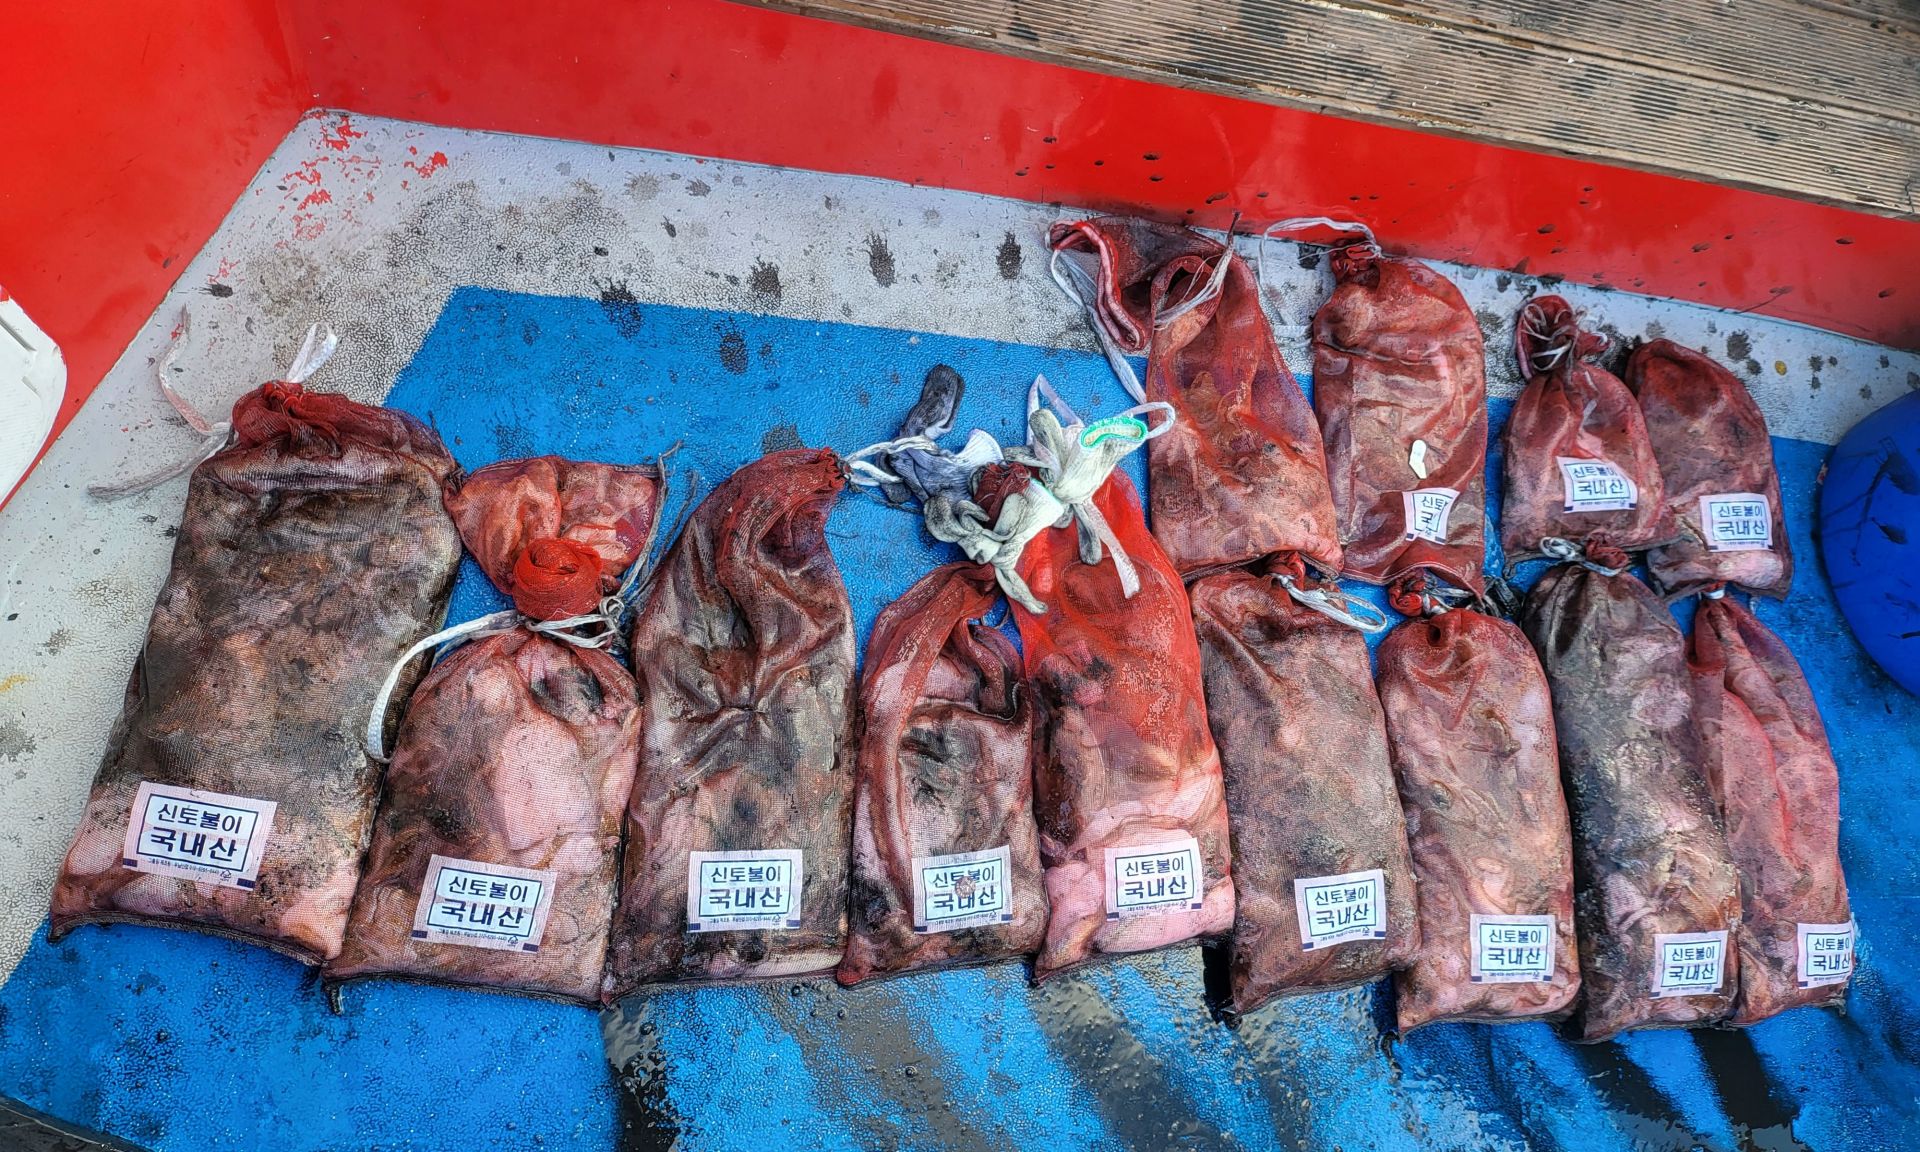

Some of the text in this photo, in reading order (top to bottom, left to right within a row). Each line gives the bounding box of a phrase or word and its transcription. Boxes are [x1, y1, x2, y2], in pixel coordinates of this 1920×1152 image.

[1577, 479, 1624, 495] 국내산
[1718, 505, 1763, 518] 신토불이
[1717, 520, 1765, 536] 국내산
[157, 803, 243, 834] 신토불이
[150, 826, 238, 862] 국내산
[711, 866, 782, 883] 신토불이
[1124, 856, 1185, 877] 신토불이
[448, 876, 529, 903] 신토불이
[1124, 875, 1188, 899] 국내산
[1314, 885, 1369, 906] 신토불이
[708, 887, 783, 909] 국내산
[933, 885, 997, 912] 국내산
[441, 898, 524, 929] 국내산
[1315, 903, 1370, 928] 국내산
[1488, 929, 1542, 943] 신토불이
[1487, 947, 1542, 966] 국내산
[1671, 945, 1715, 961] 신토불이
[1812, 952, 1851, 971] 국내산
[1668, 963, 1715, 981] 국내산
